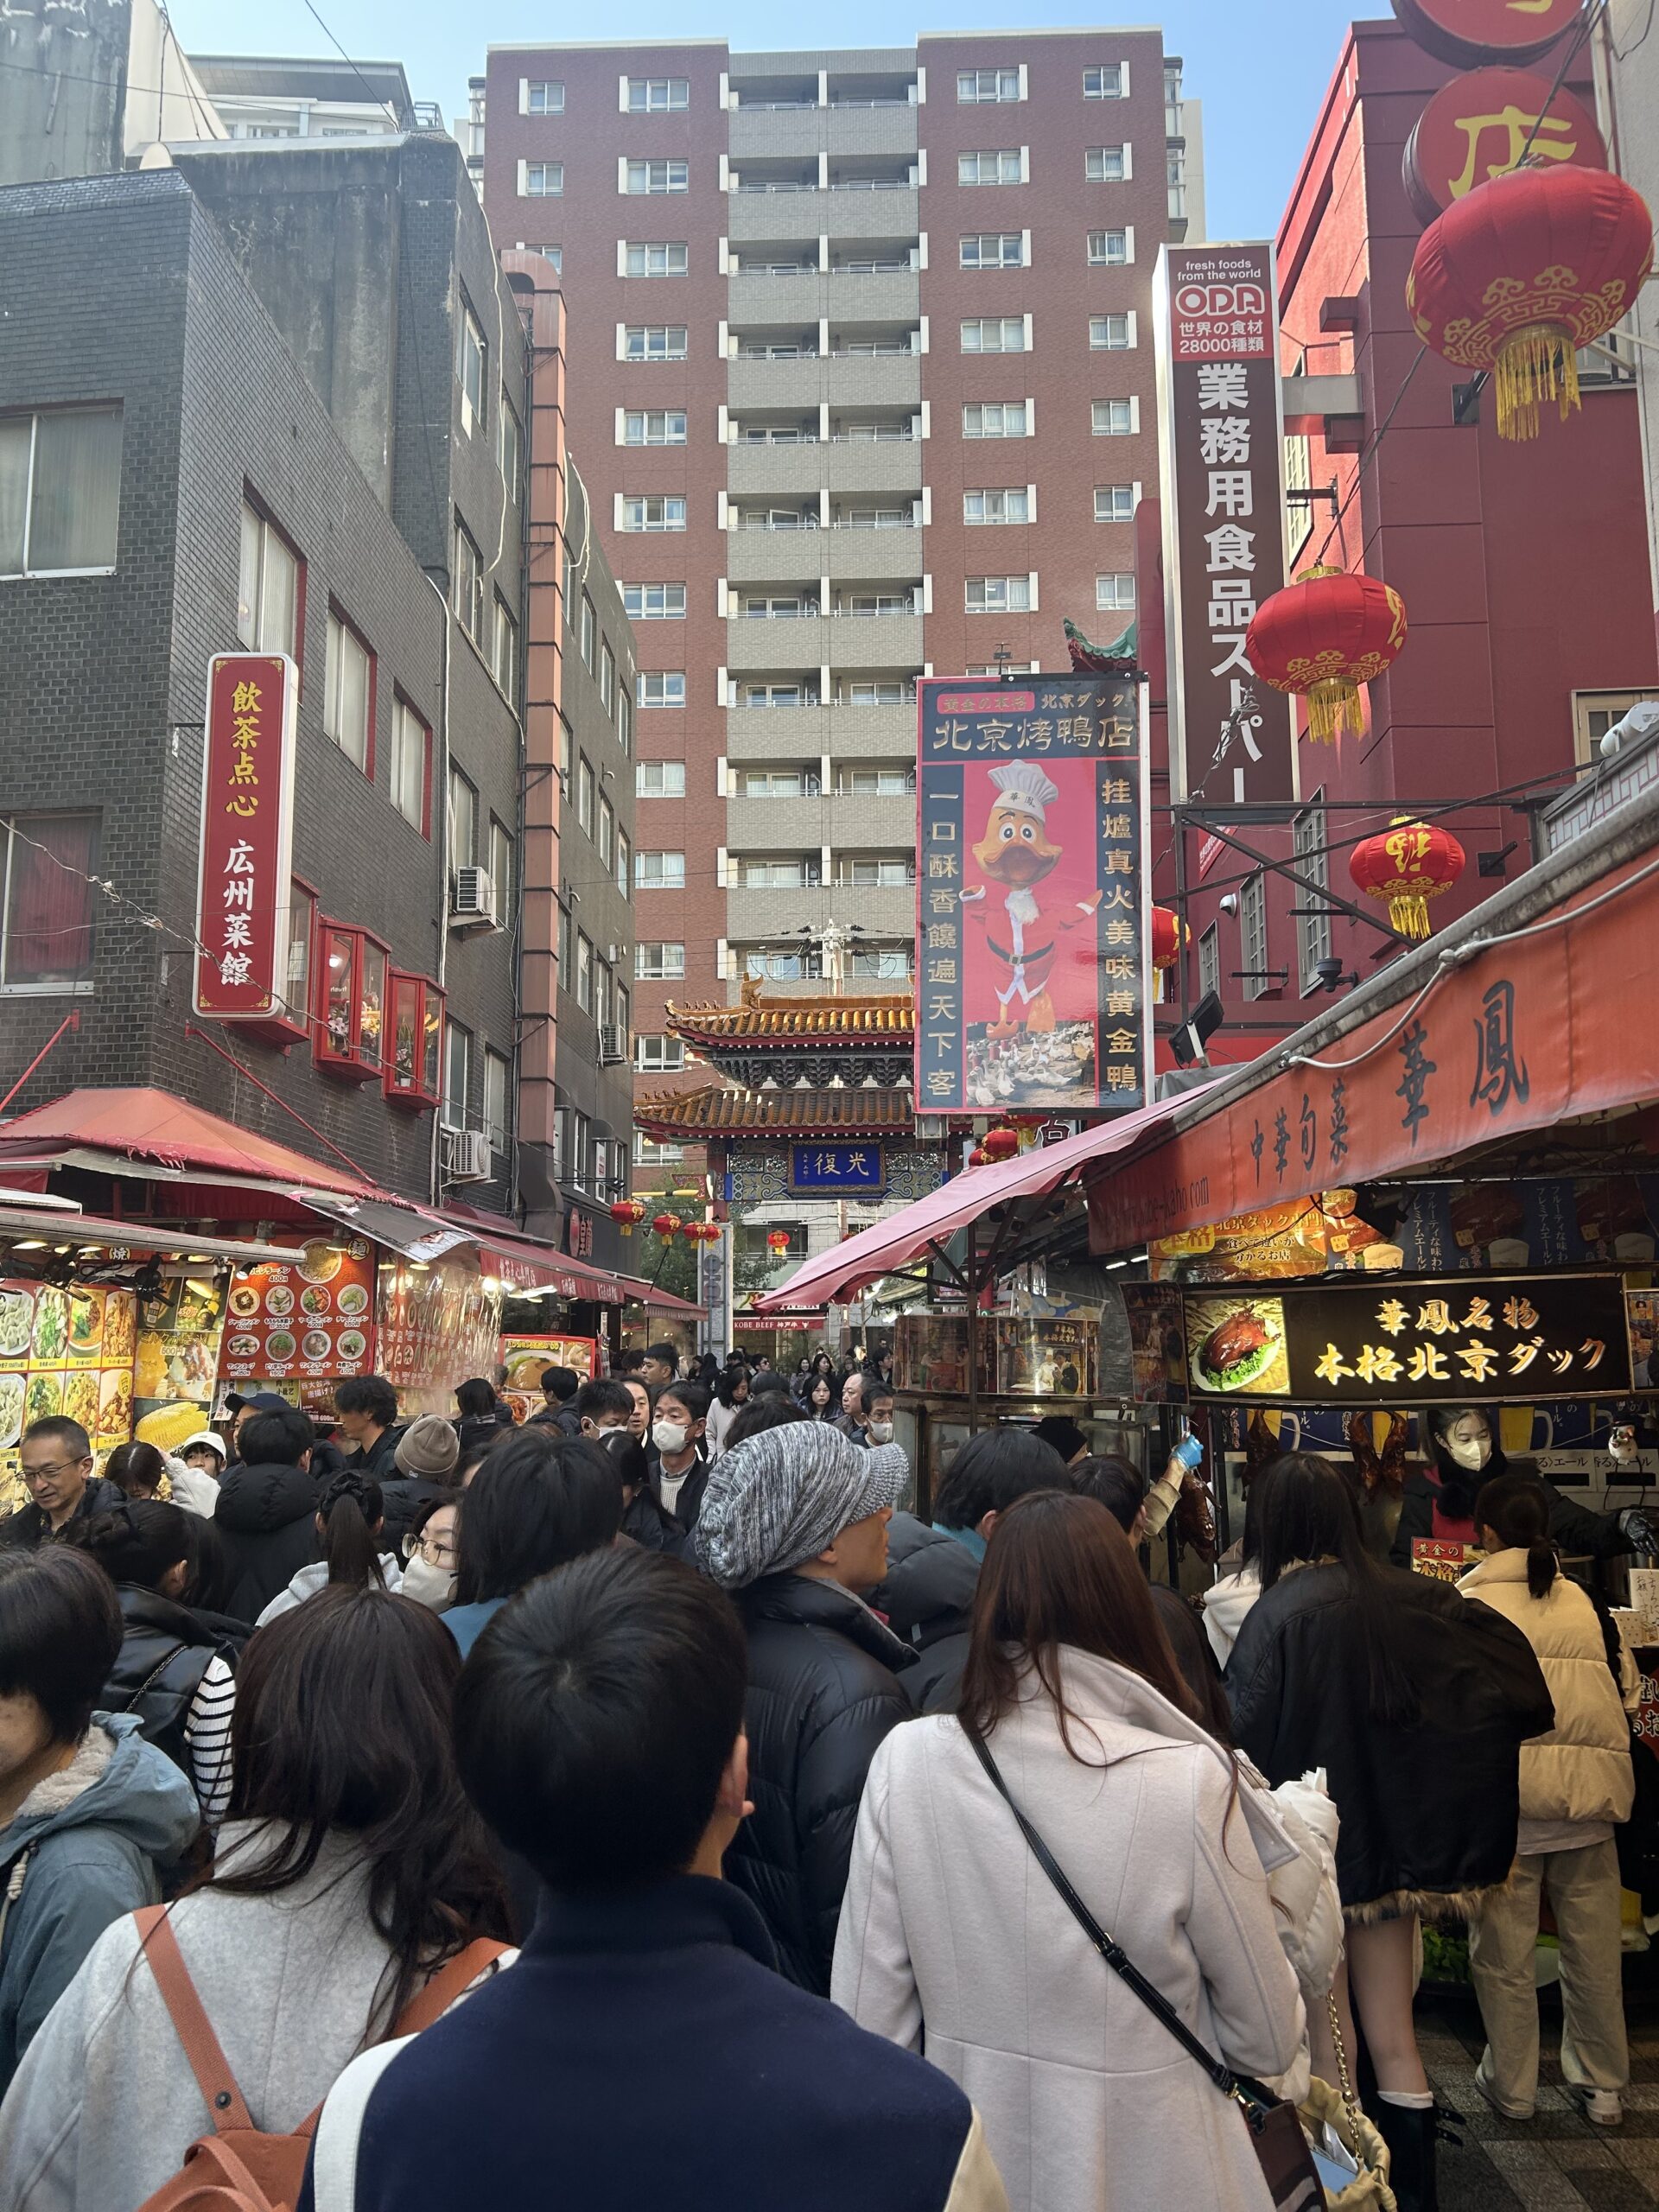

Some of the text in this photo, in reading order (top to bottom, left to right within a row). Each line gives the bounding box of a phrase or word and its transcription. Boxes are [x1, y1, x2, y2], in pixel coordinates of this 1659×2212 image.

[1178, 269, 1262, 282] from the world
[1185, 259, 1252, 270] fresh foods
[1175, 283, 1265, 317] ODA
[1179, 320, 1263, 337] 世界の食材
[1179, 336, 1264, 353] 28000種類
[1197, 363, 1263, 803] 業務用食品スーパー
[944, 692, 1125, 712] 黄金の本格 北京ダック
[932, 715, 1134, 752] 北京烤鴨店
[220, 681, 263, 988] 飲茶点心 広州菜館
[1395, 979, 1529, 1148] 華鳳
[1375, 1295, 1541, 1336] 華鳳名物
[1313, 1336, 1606, 1385] 本格北京ダック
[1416, 1542, 1459, 1557] 黄金の
